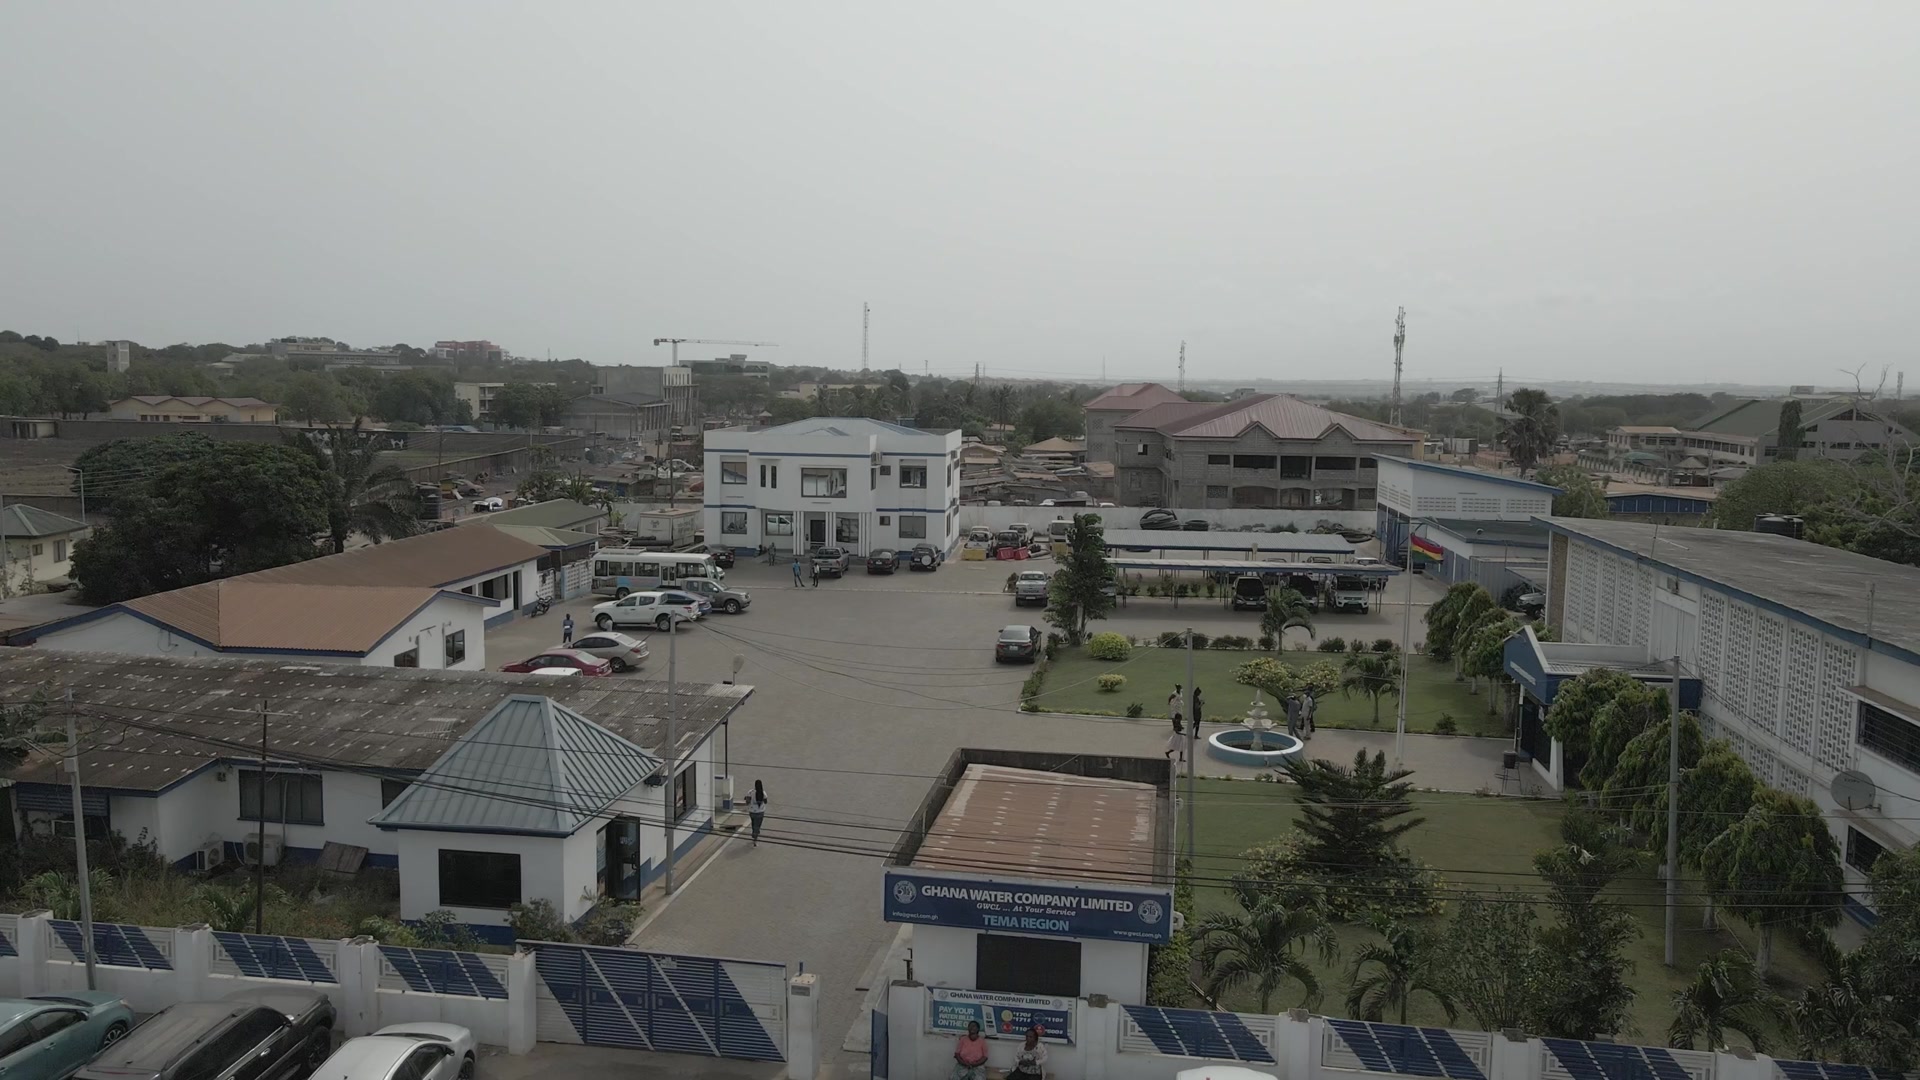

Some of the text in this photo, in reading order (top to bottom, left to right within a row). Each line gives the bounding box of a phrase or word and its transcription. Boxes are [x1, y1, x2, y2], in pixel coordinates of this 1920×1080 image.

[921, 885, 1134, 913] GHANA WATER COMPANY LIMITED
[976, 902, 1001, 911] GWCL
[1025, 906, 1044, 914] Your
[1046, 908, 1076, 917] Service
[982, 914, 1070, 932] TEMA REGION
[1112, 930, 1162, 940] www.gwcl.com.gh
[994, 995, 1025, 1003] COMPANY
[954, 1007, 974, 1015] YOUR
